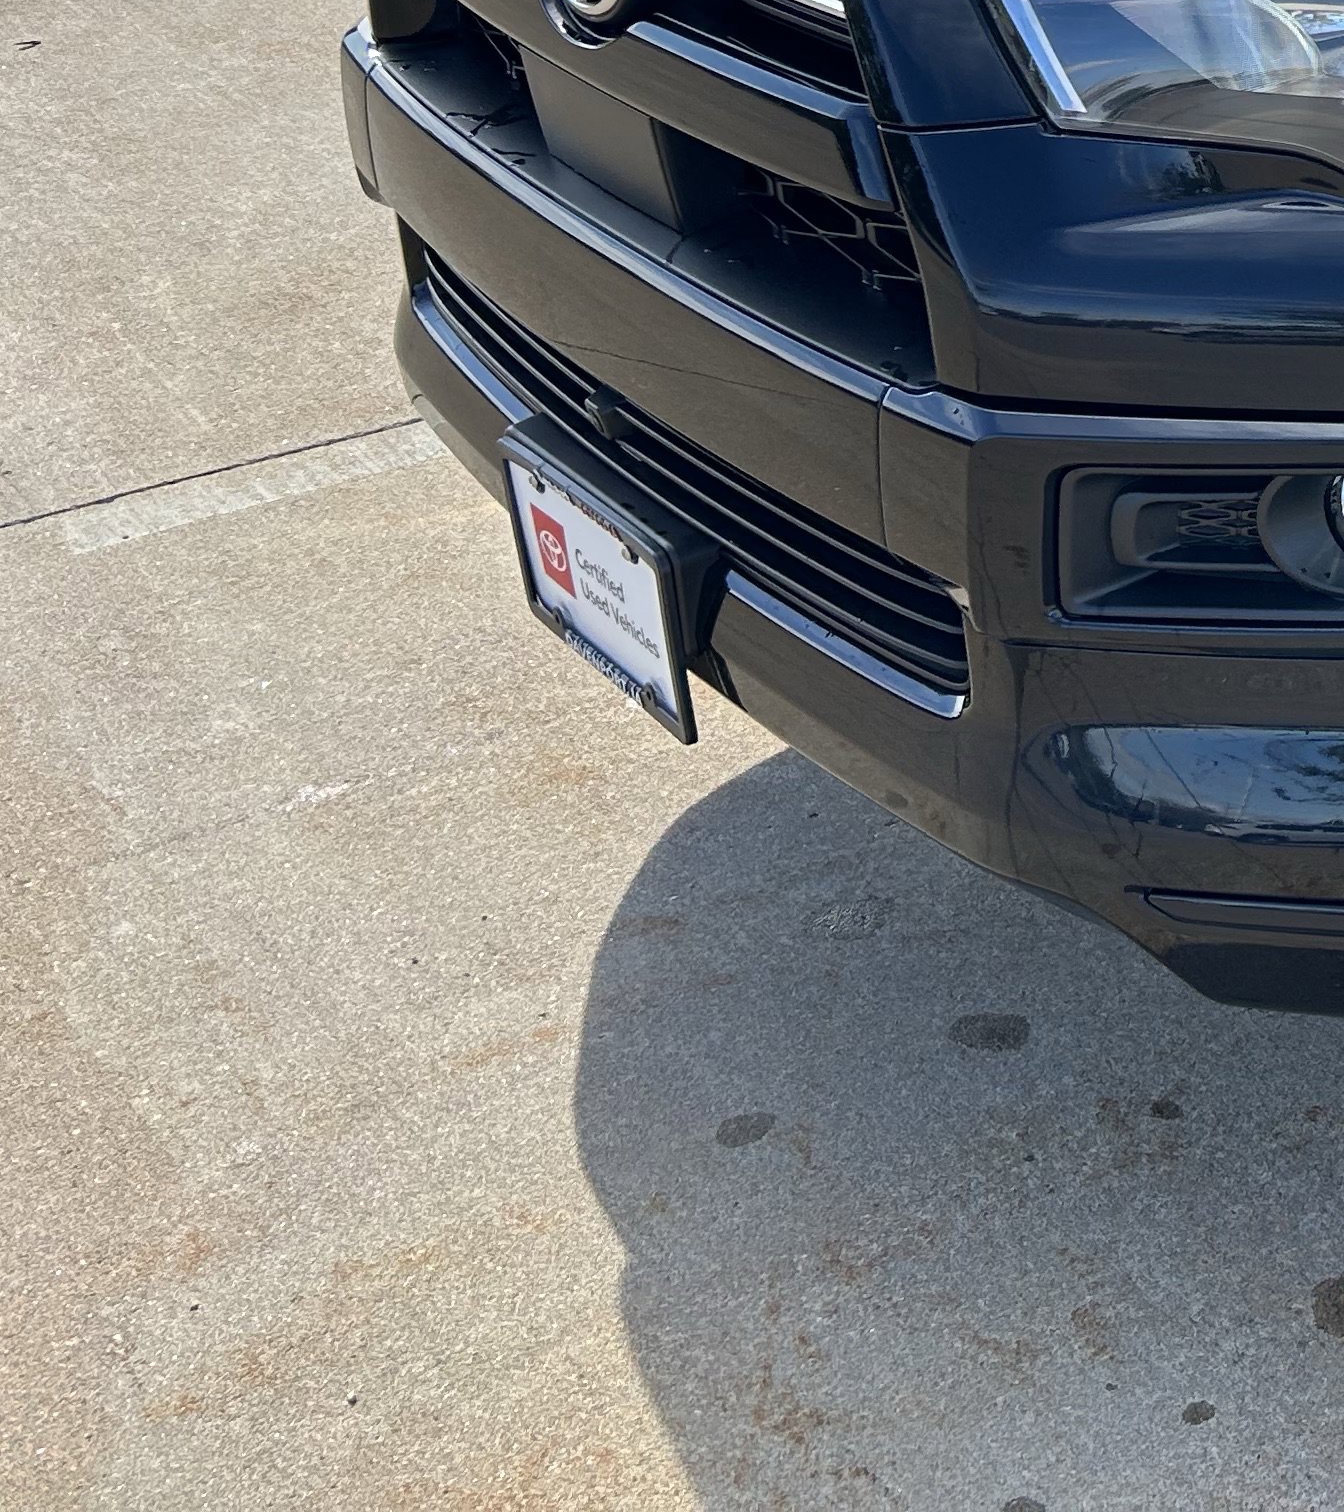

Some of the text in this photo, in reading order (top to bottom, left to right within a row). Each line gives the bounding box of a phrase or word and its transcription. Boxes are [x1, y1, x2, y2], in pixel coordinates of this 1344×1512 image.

[575, 548, 626, 603] Certified
[580, 577, 660, 658] Used Vehicles
